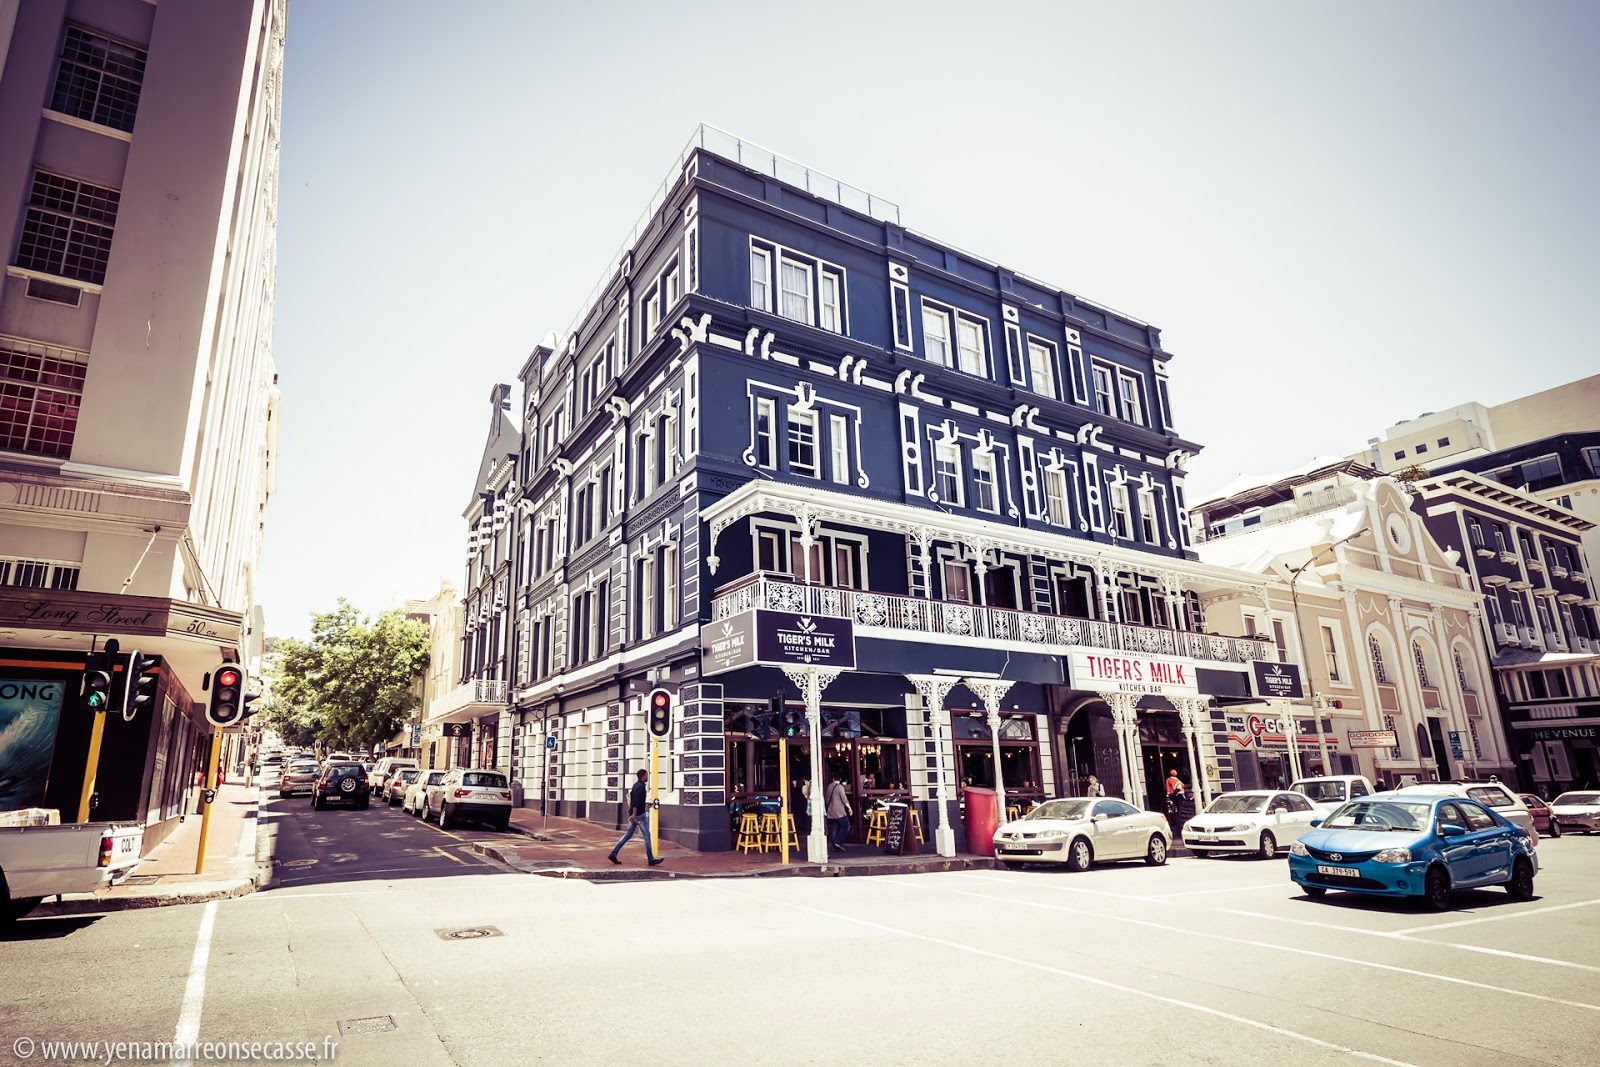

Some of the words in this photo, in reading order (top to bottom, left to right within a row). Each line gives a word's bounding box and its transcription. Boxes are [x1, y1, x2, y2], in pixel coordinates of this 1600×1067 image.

[19, 600, 79, 626] Long
[87, 604, 152, 626] Street
[187, 619, 206, 634] 50
[711, 639, 731, 654] TIGER'S
[731, 636, 745, 648] MILK
[777, 633, 812, 646] TIGER'S
[814, 636, 835, 648] MILK
[784, 645, 830, 654] KITCHEN/BAR
[1087, 656, 1143, 681] TIGERS
[1149, 662, 1186, 685] MILK
[1551, 728, 1596, 738] VENUE
[121, 837, 136, 853] COLT
